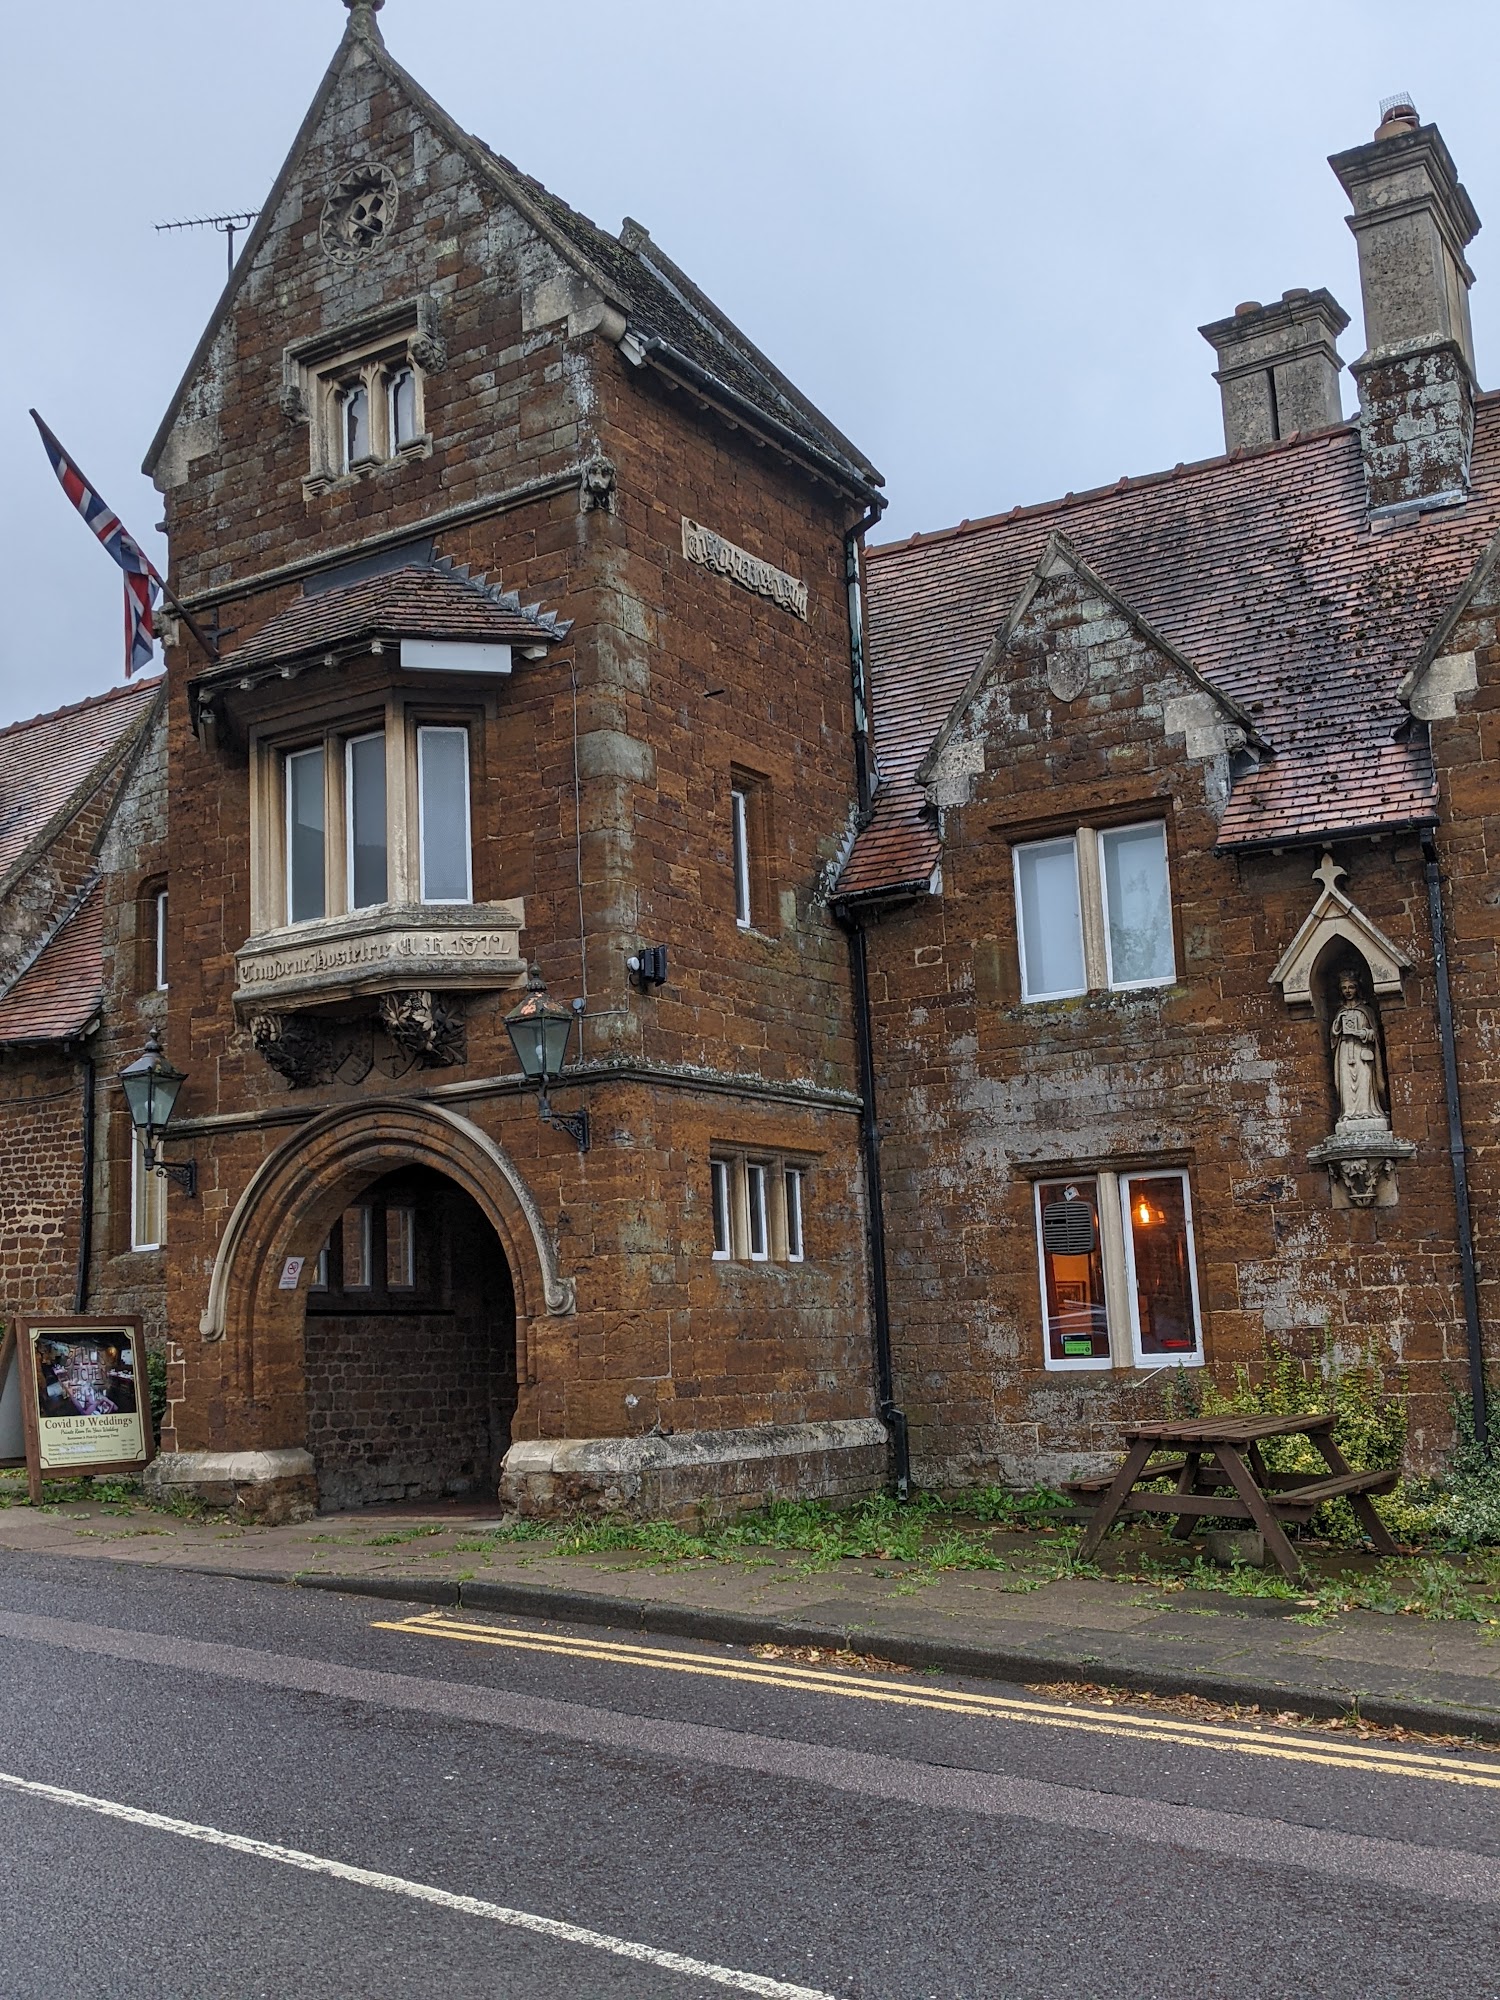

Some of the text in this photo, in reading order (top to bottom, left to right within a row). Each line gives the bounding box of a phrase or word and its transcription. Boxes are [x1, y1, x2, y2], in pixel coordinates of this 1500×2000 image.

[45, 1416, 133, 1429] Covid 19 Weddings
